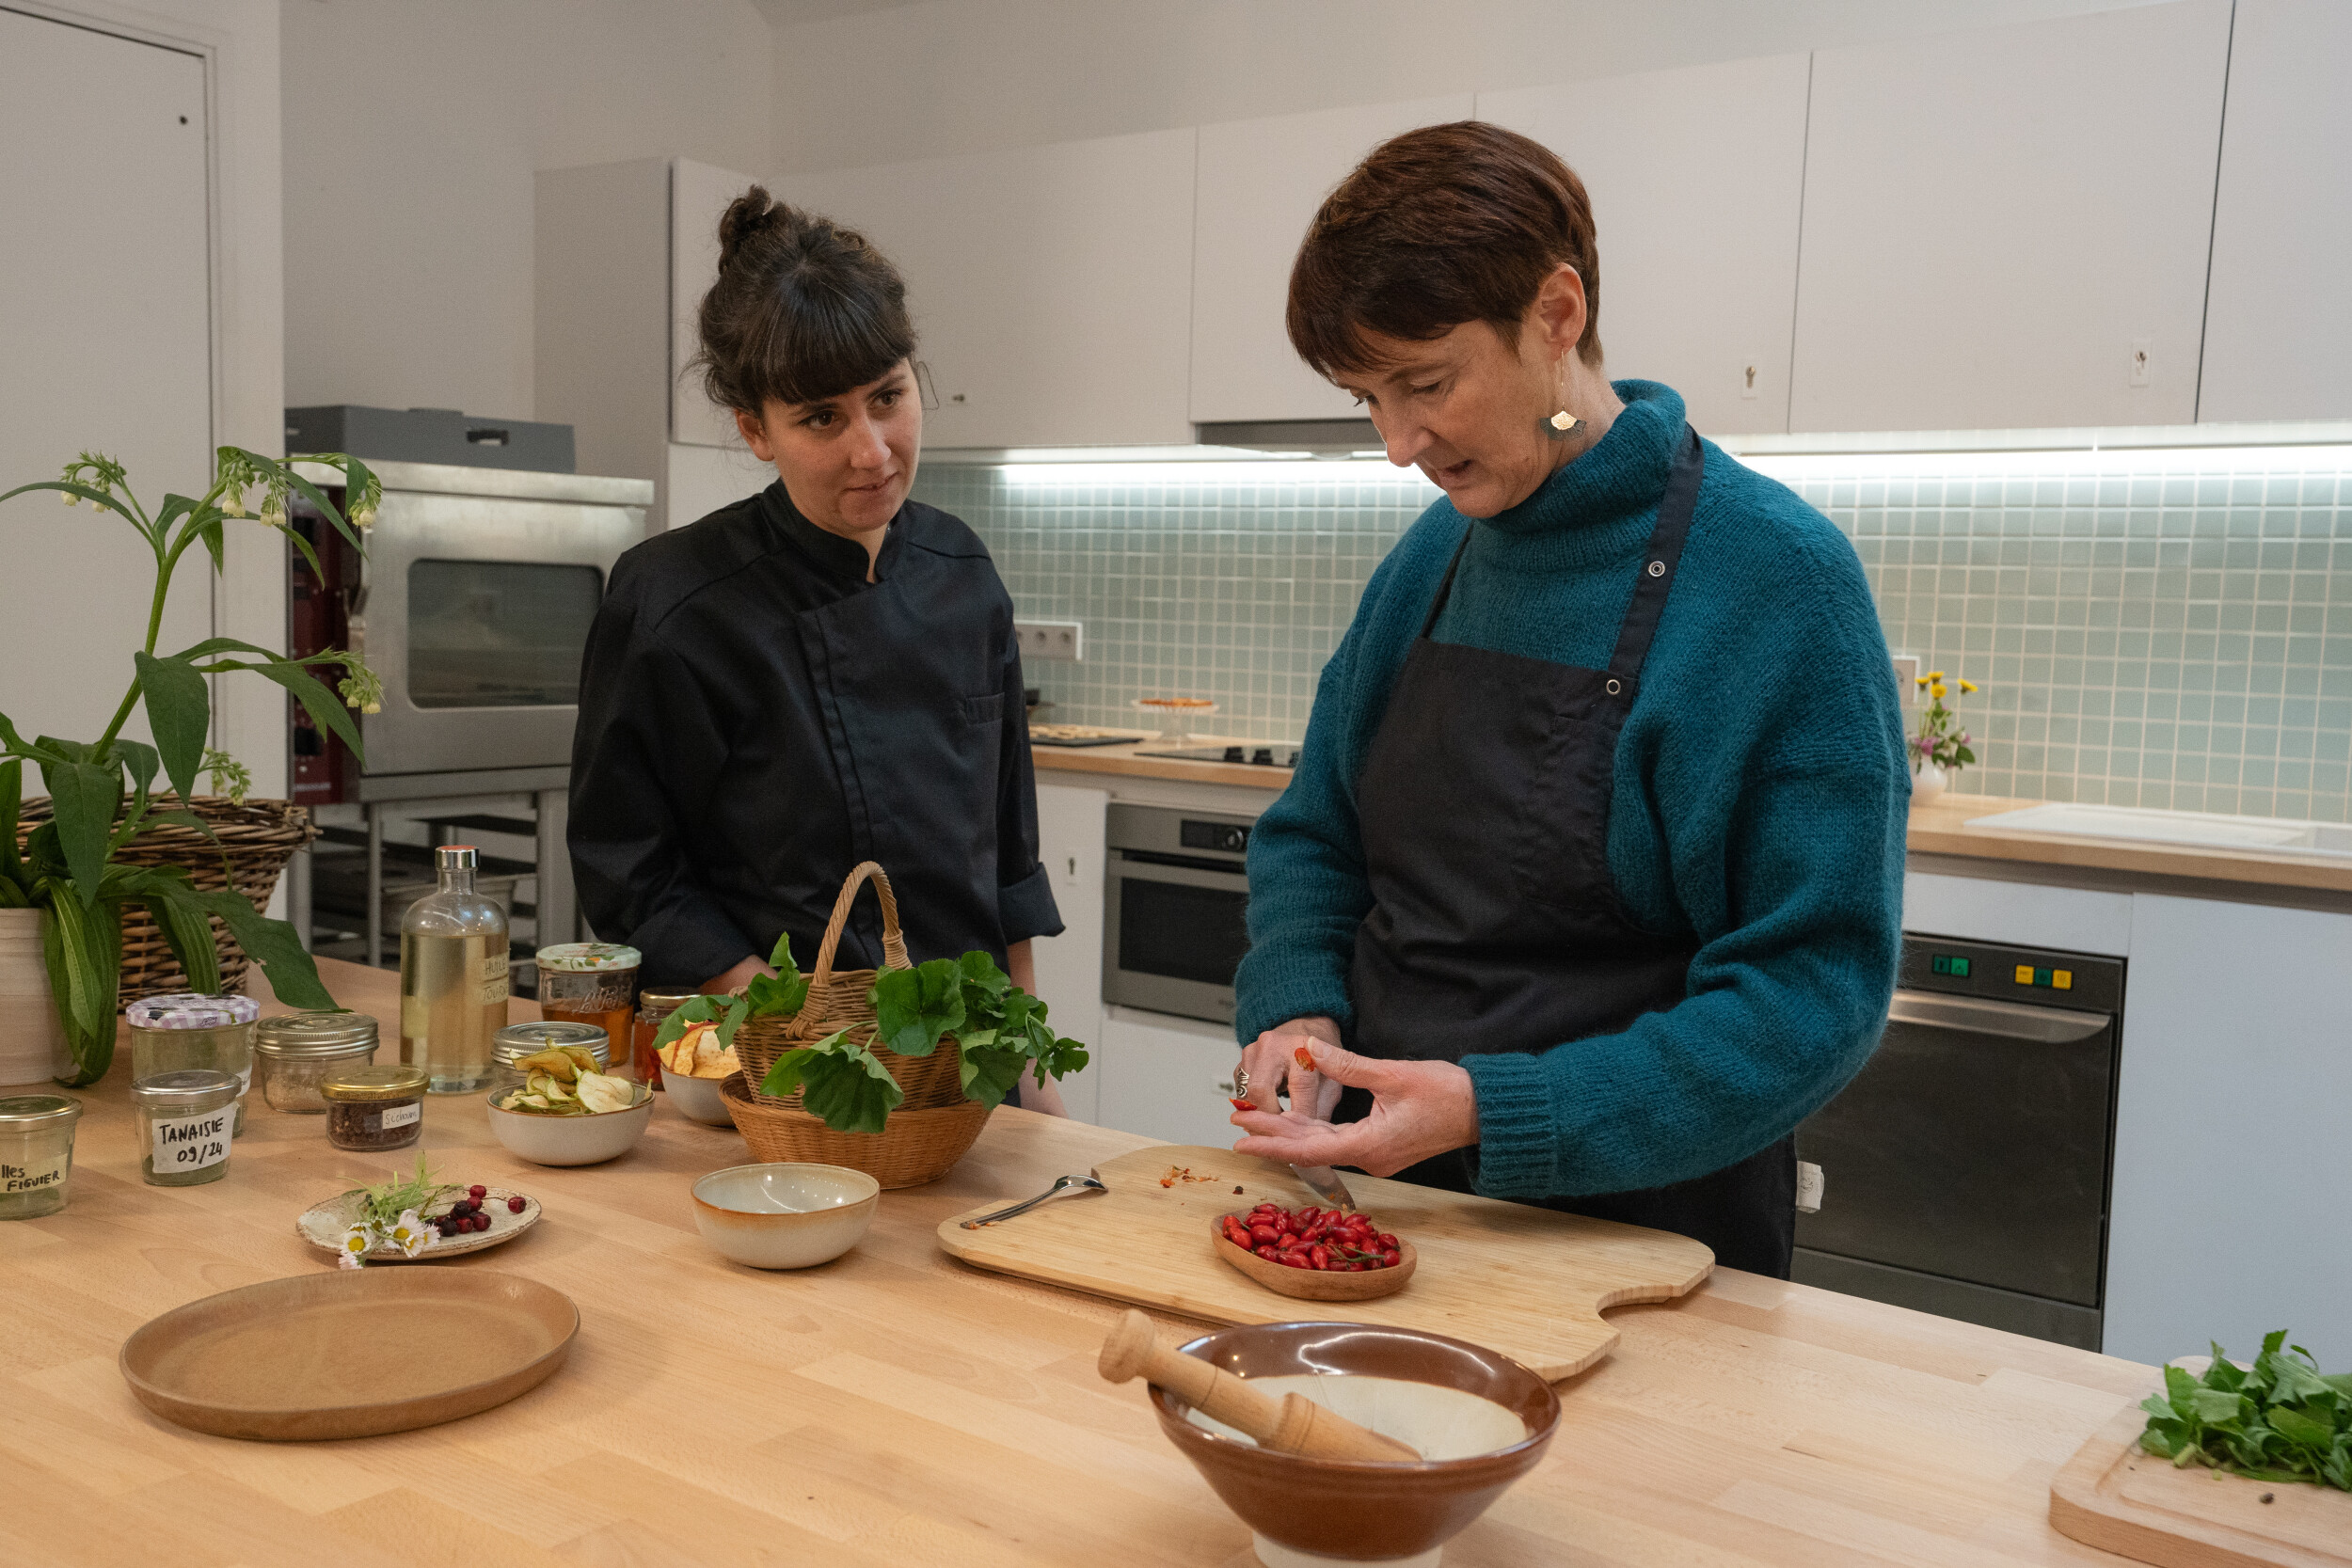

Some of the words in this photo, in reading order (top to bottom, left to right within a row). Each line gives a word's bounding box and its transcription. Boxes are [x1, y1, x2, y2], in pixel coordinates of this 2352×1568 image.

[159, 1117, 224, 1145] TANAISIE
[177, 1142, 223, 1164] 09/24
[1, 1164, 25, 1179] lles
[7, 1170, 60, 1192] FIGUIER
